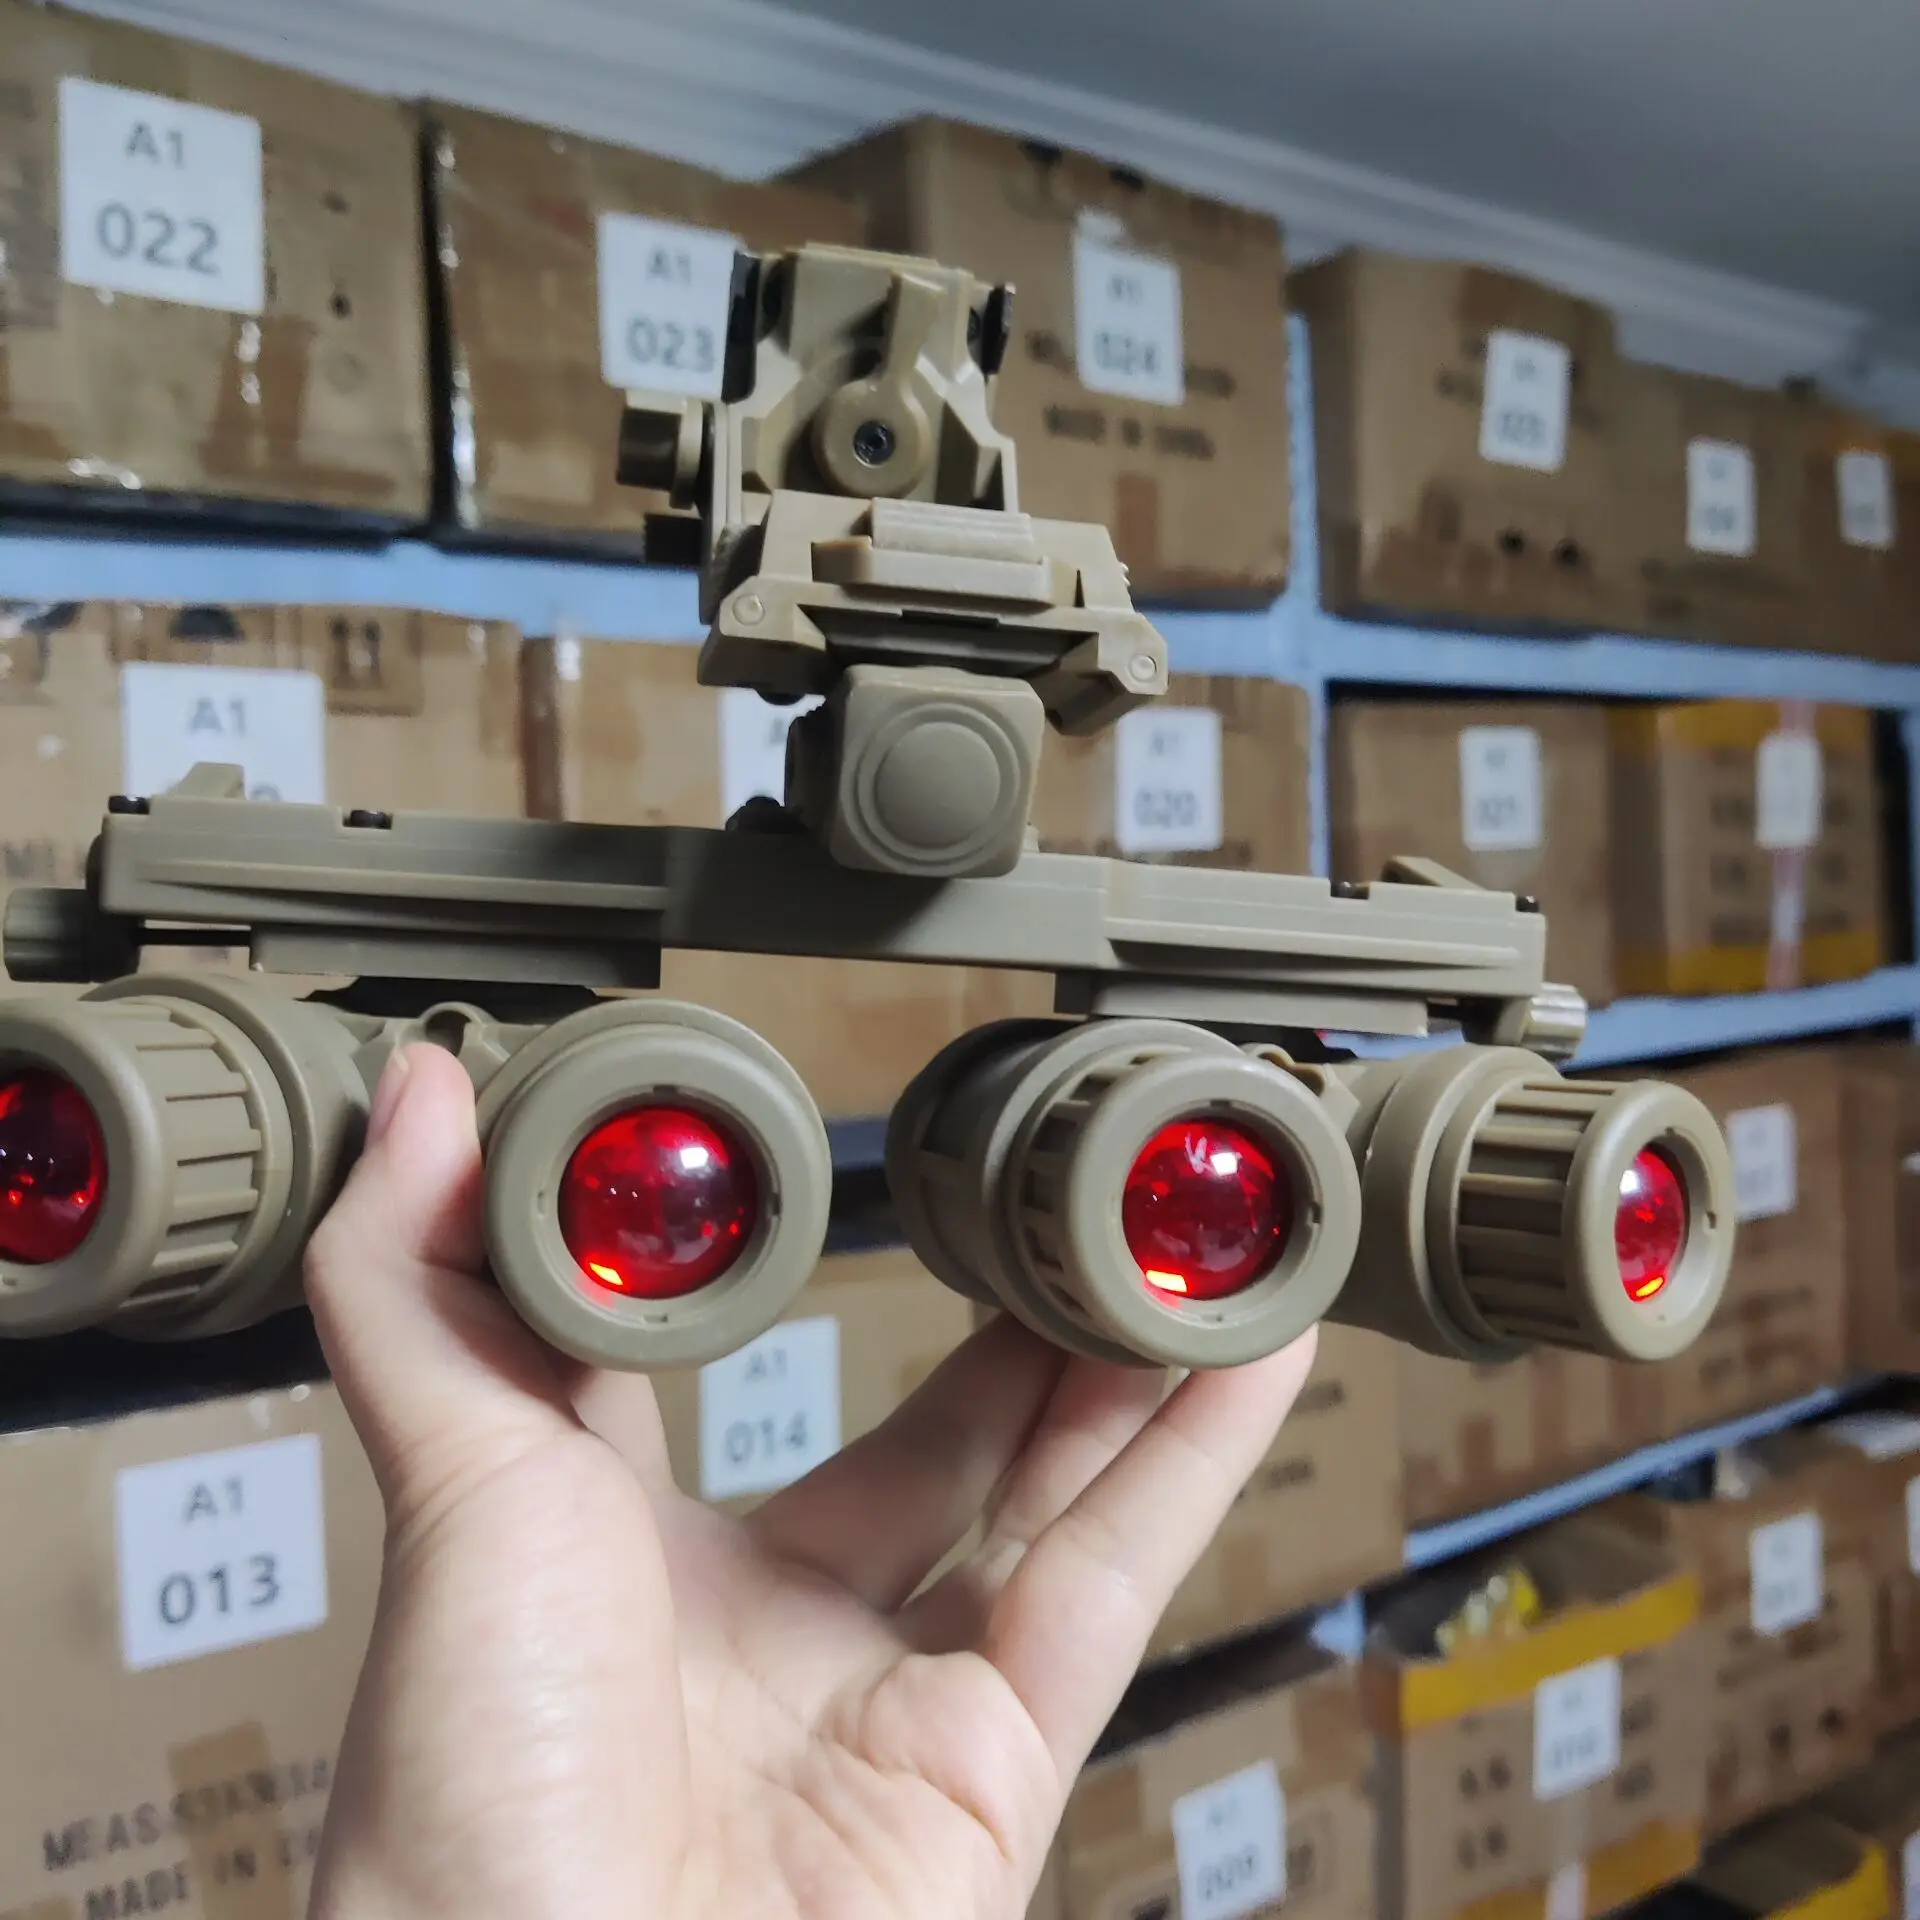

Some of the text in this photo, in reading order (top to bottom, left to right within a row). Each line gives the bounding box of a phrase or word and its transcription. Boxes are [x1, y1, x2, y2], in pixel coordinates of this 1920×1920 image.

[124, 120, 187, 170] A1
[96, 200, 222, 277] 022
[648, 246, 692, 290] A1
[627, 316, 715, 374] 023
[186, 692, 249, 740] A1
[742, 1346, 790, 1386] A1
[722, 1412, 812, 1468] 014
[182, 1475, 245, 1526] A1
[157, 1550, 283, 1630] 013
